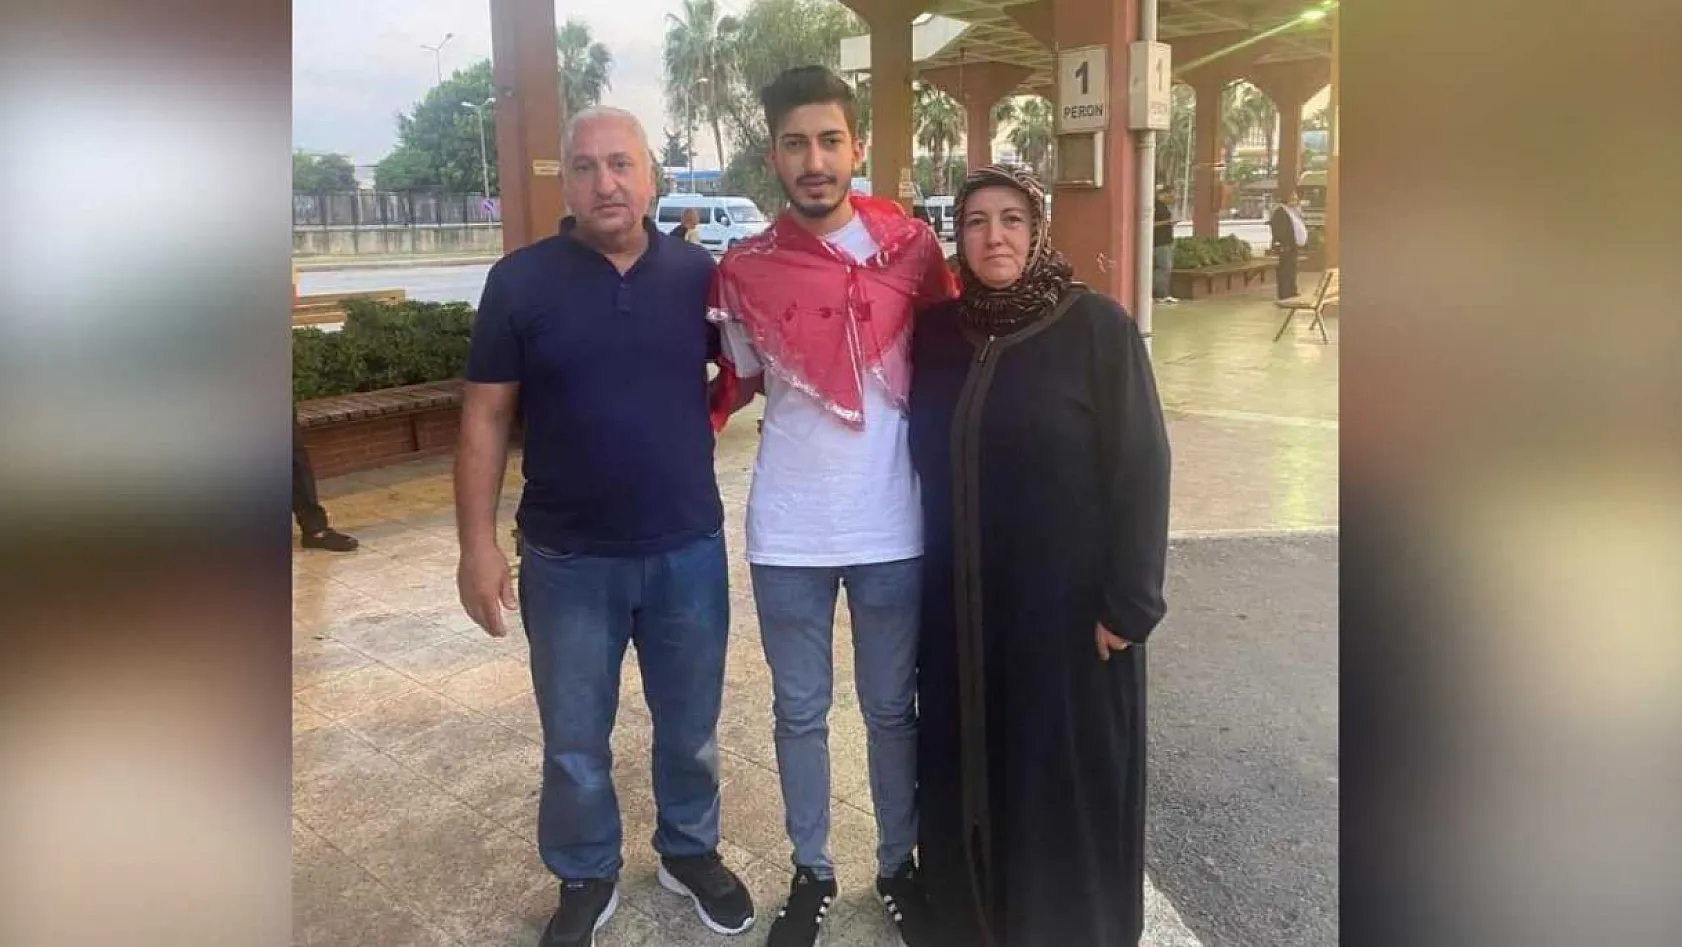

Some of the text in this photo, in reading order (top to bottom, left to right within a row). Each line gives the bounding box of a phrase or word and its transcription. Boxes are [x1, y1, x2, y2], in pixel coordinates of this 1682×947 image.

[1075, 61, 1088, 94] 1
[1155, 57, 1163, 92] 1
[1063, 104, 1103, 119] PERON
